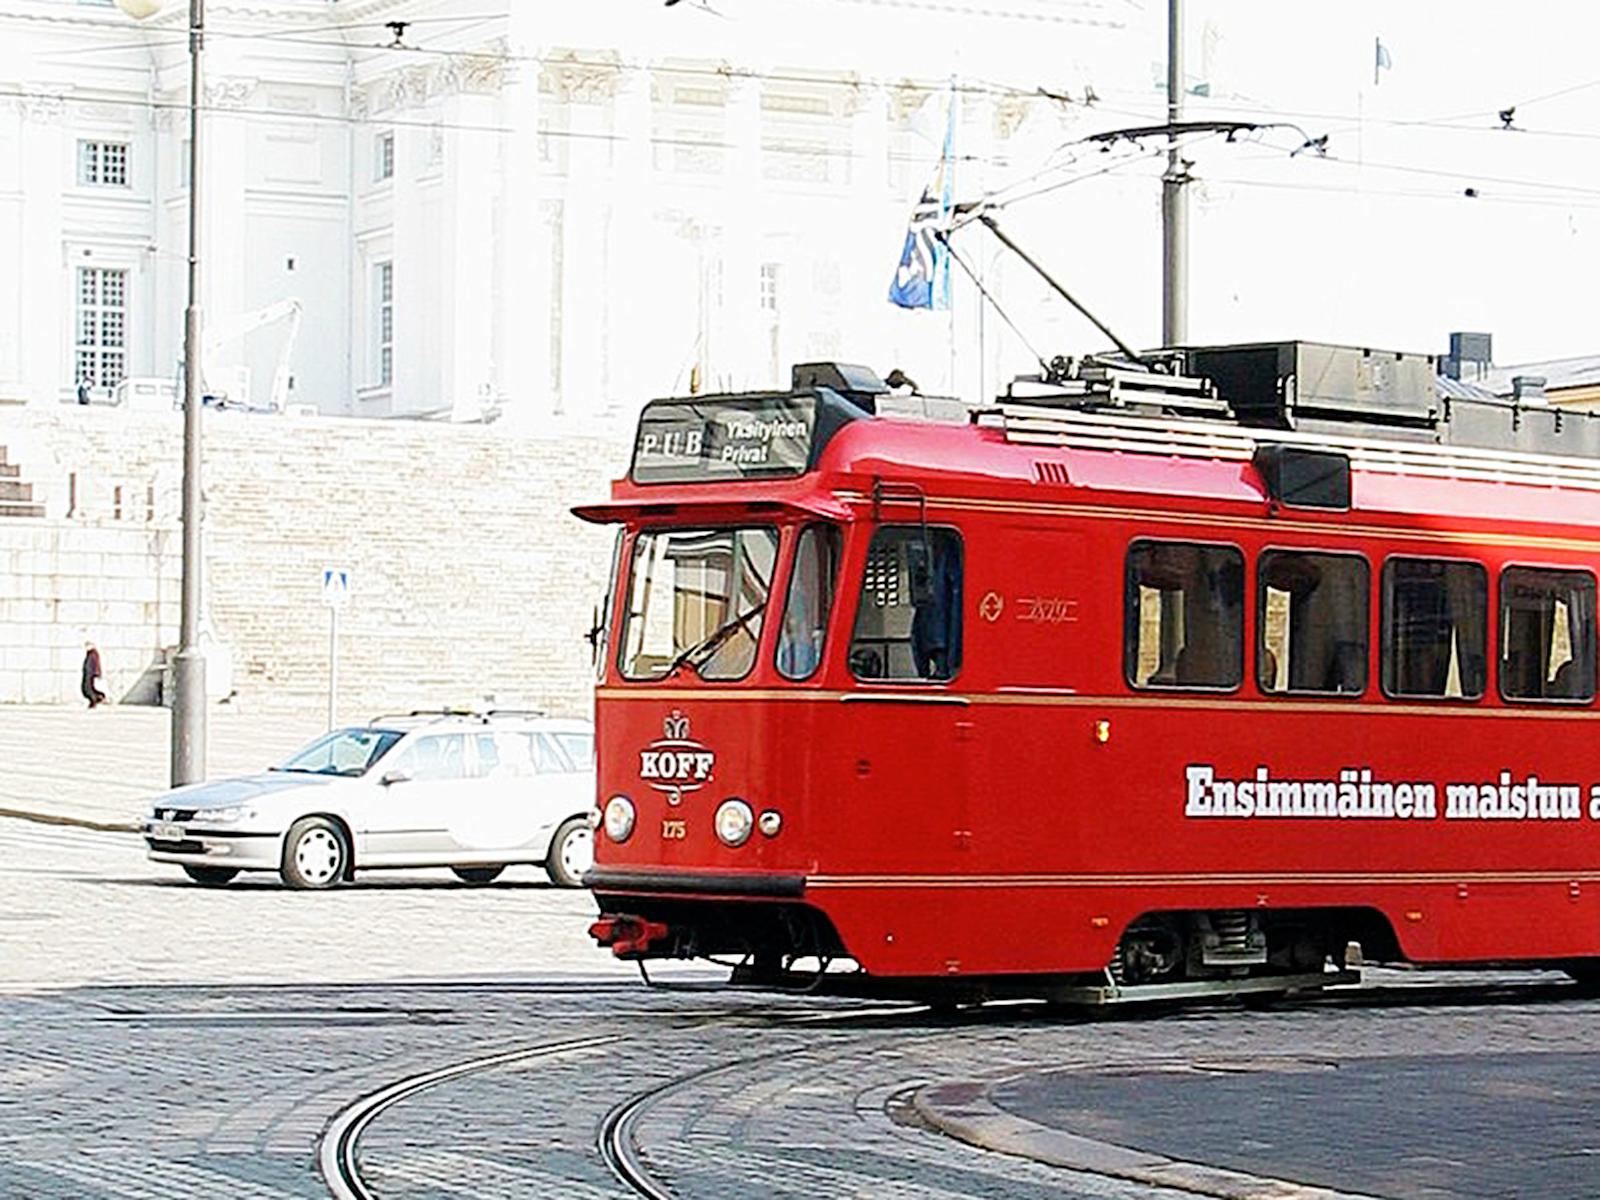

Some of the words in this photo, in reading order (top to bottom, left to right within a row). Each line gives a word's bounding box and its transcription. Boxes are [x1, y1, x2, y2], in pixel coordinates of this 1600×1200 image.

[721, 445, 768, 463] Privat
[1185, 766, 1437, 818] Ensimmäinen
[1445, 772, 1581, 819] maistuu
[662, 820, 686, 839] 175
